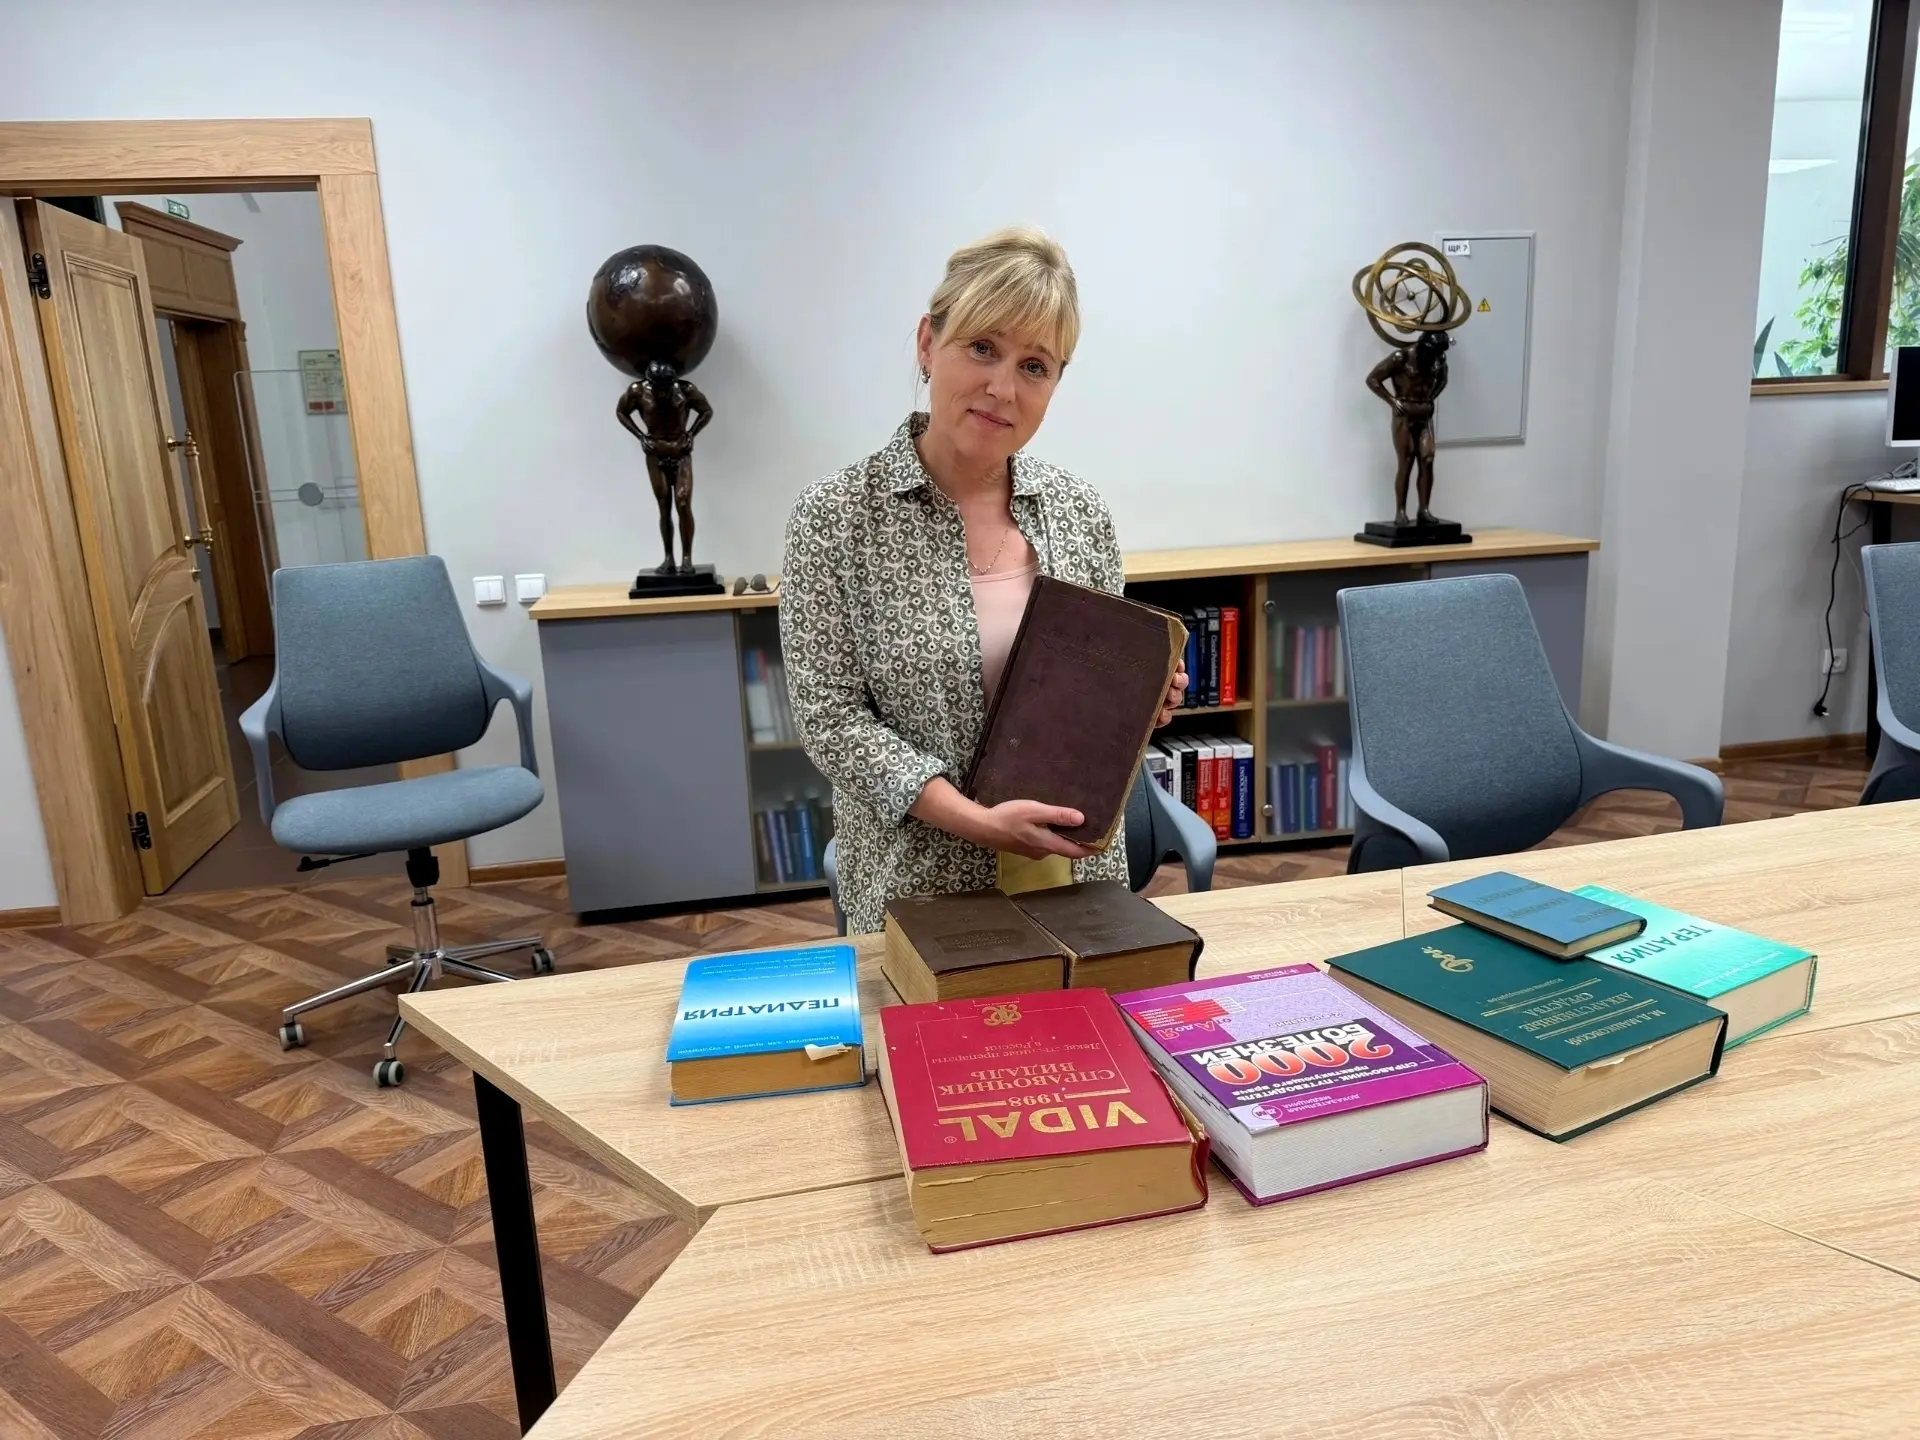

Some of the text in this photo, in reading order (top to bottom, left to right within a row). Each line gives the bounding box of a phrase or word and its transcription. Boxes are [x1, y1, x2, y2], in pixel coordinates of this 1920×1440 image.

[1611, 924, 1712, 965] ТЕРАПИЯ
[683, 998, 839, 1021] ПЕДИАТРИЯ
[1518, 991, 1634, 1034] ЛЕКАРСТВЕННЫЕ
[1522, 992, 1594, 1017] СРЕДСТВА
[1156, 1028, 1173, 1041] Я
[1564, 1016, 1641, 1047] МАШКОВСКИЙ
[1192, 1023, 1367, 1066] БОЛЕЗНЕЙ
[931, 1050, 1001, 1065] препараты
[1207, 1035, 1393, 1085] 2000
[938, 1069, 1115, 1096] СПРАВОЧНИК
[970, 1062, 1077, 1080] ВИДАЛЬ
[1232, 1065, 1369, 1096] практикующего врача
[1008, 1092, 1063, 1107] 1998
[1282, 1096, 1332, 1109] МЕДИЦИНА
[1286, 1093, 1361, 1113] ДОКАЗАТЕЛЬНАЯ
